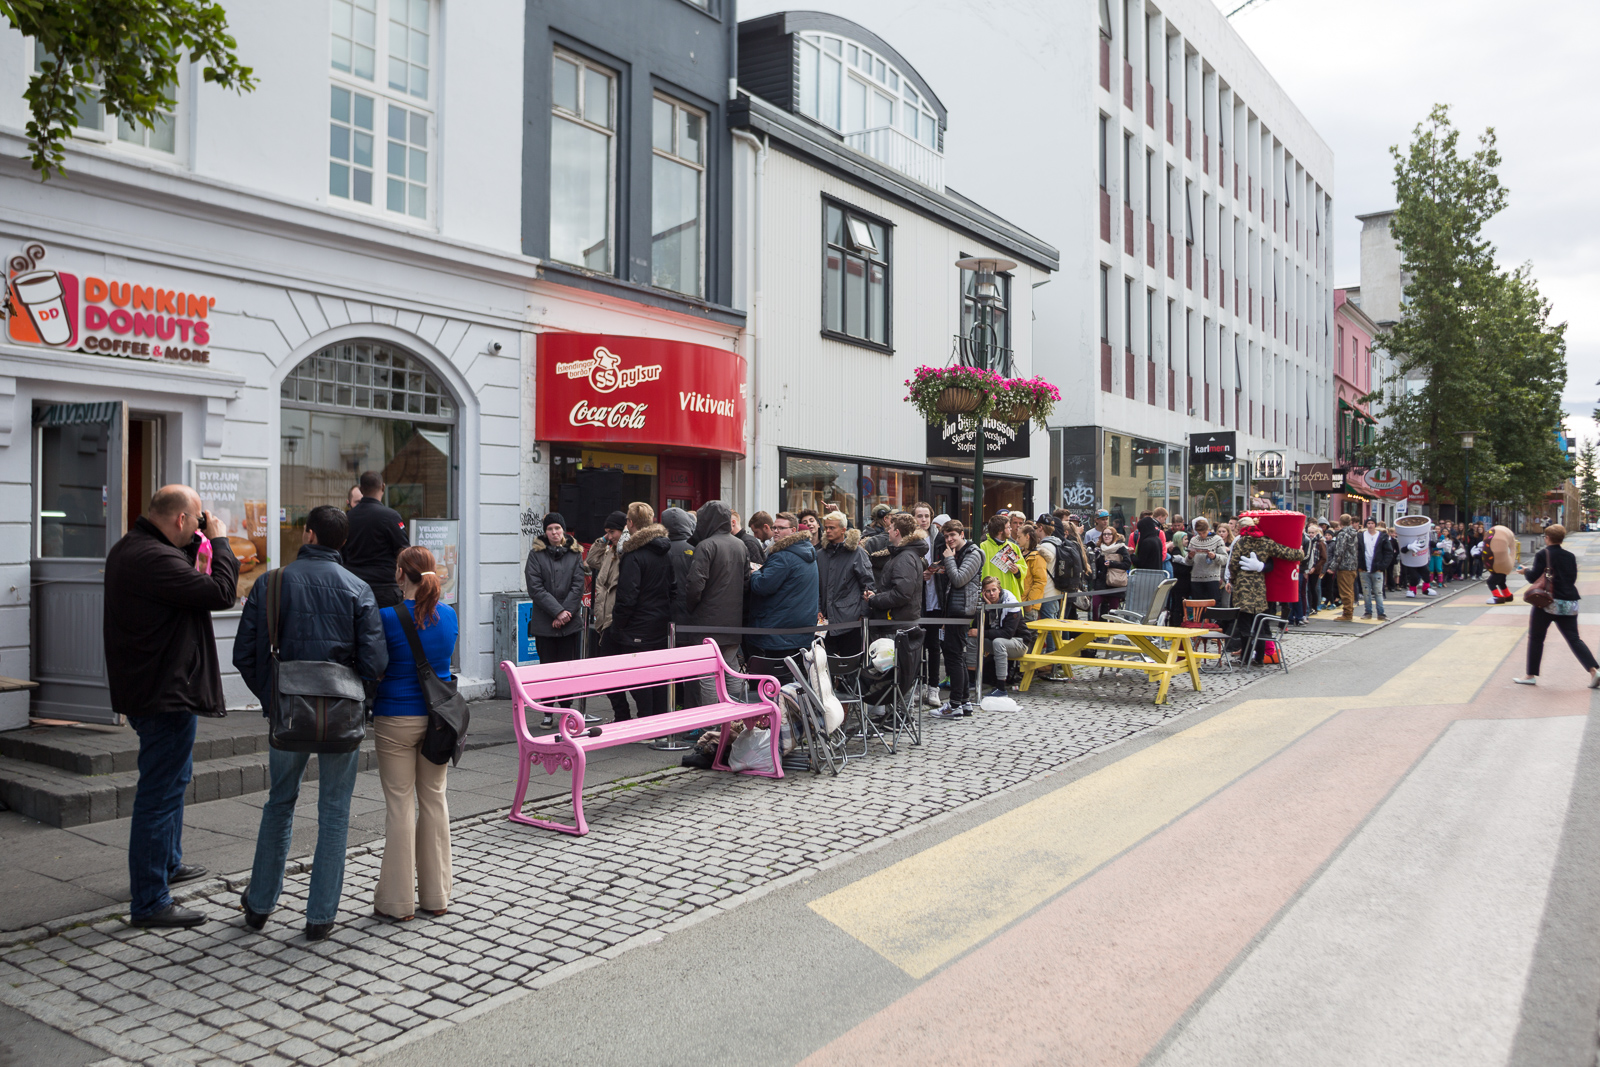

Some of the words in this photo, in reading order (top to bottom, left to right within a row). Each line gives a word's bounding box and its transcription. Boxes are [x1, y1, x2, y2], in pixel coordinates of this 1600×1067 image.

[85, 277, 216, 319] DUNKIN'
[38, 308, 60, 321] DD
[85, 305, 210, 345] DONUTS
[84, 336, 150, 355] COFFEE
[153, 345, 163, 357] &
[164, 347, 210, 364] MORE
[595, 369, 616, 388] SS
[621, 366, 660, 386] pylsur
[569, 399, 649, 430] Coca-Cola
[679, 391, 735, 418] Vikivaki
[532, 442, 541, 463] 5
[1195, 444, 1230, 454] karlmenn
[199, 471, 240, 481] BYRJUM
[199, 481, 238, 492] DAGINN
[199, 491, 236, 501] SAMAN
